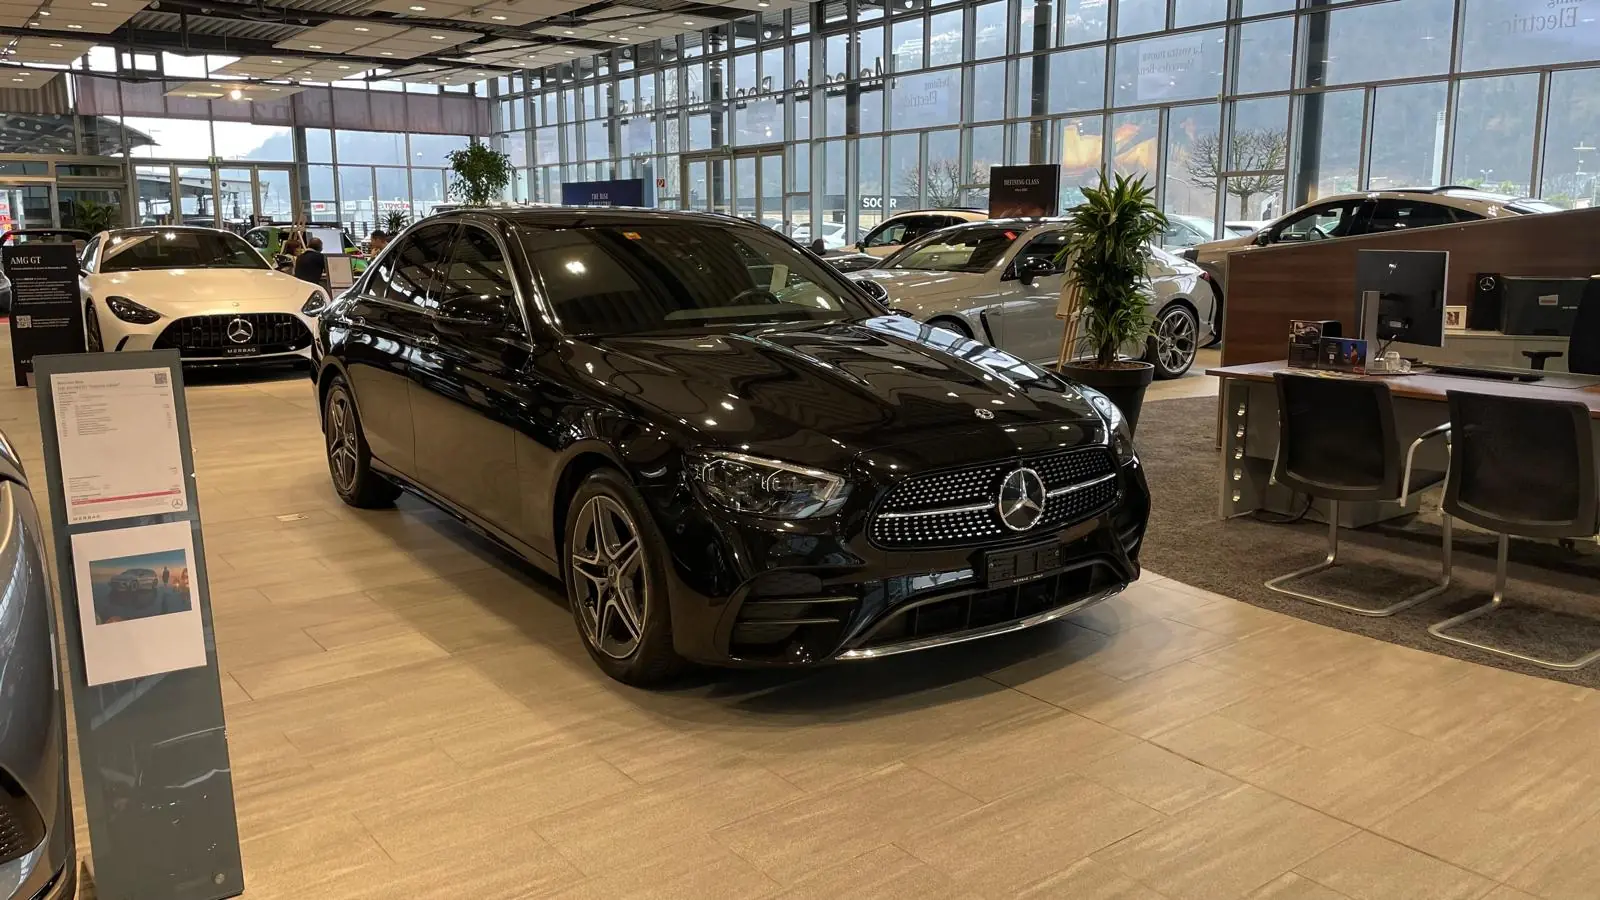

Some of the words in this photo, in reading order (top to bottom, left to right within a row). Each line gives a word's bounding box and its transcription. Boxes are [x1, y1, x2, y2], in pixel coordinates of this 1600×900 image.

[862, 197, 897, 208] SOCR
[10, 257, 29, 265] AMG
[30, 256, 42, 264] GT
